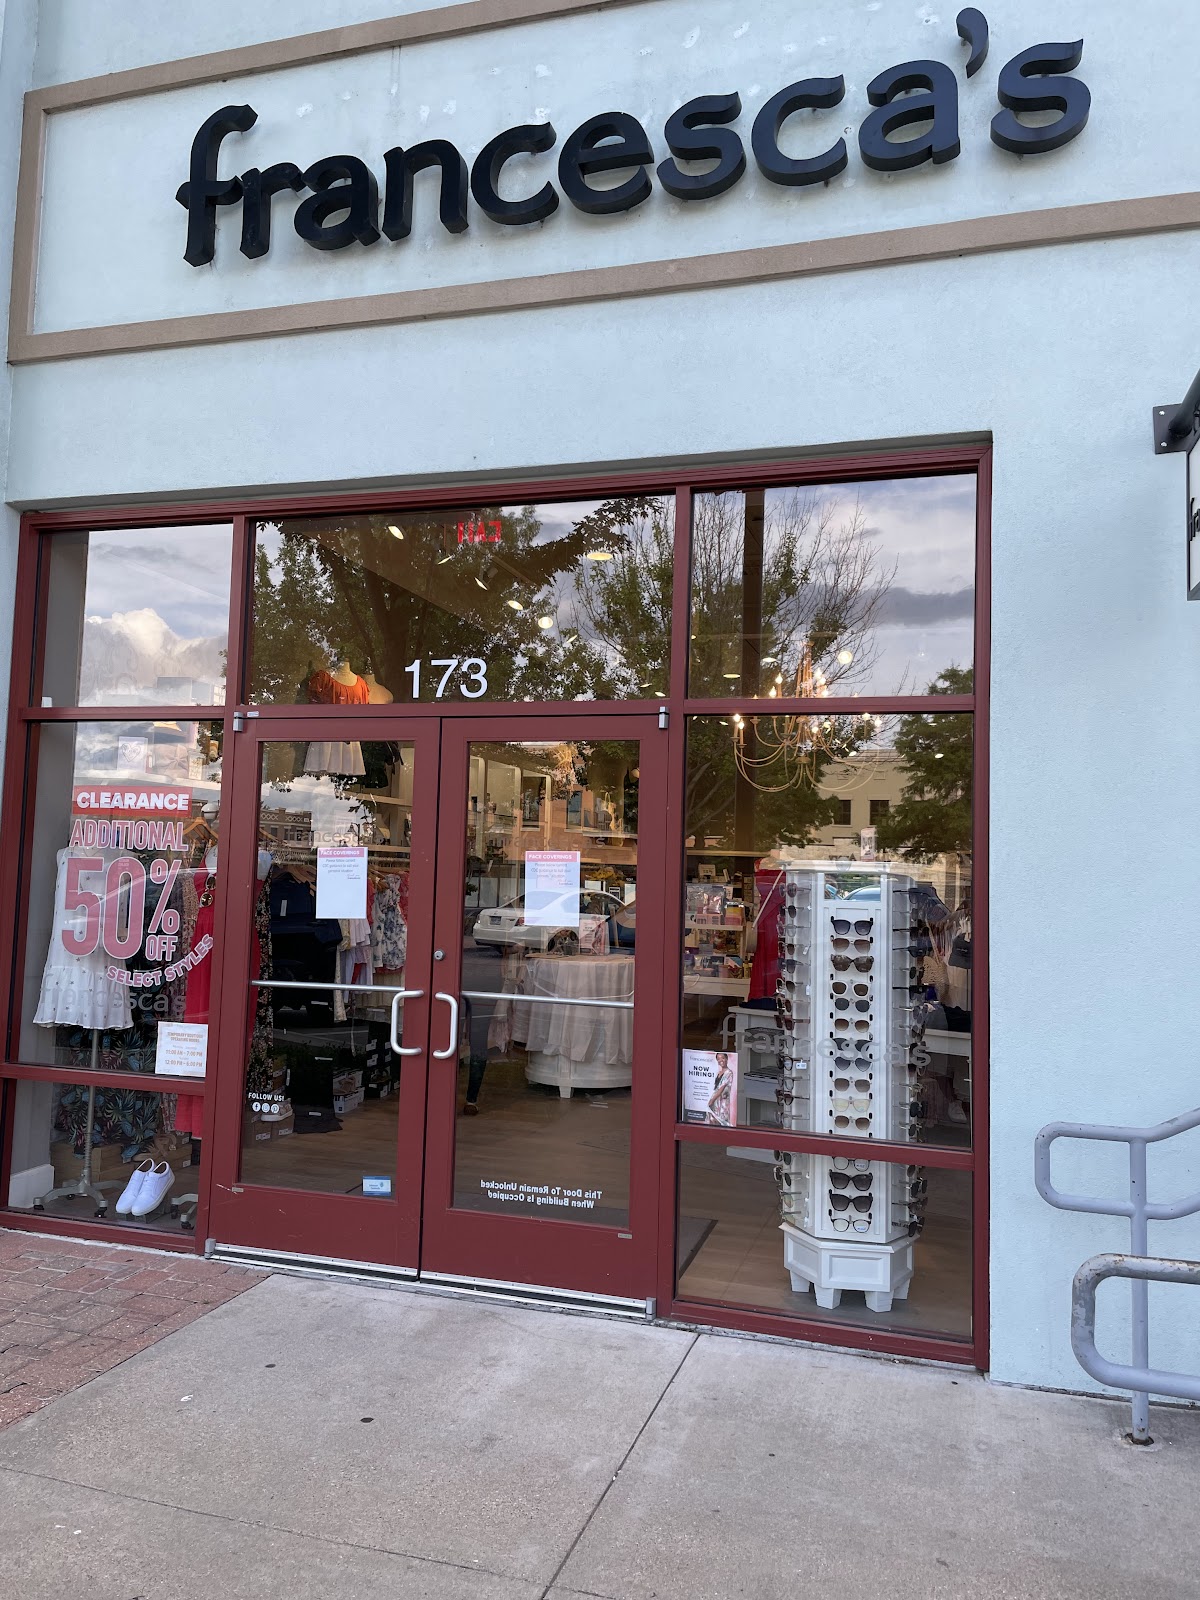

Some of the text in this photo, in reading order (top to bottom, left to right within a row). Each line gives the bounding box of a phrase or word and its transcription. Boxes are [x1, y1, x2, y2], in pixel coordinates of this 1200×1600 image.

[175, 7, 1092, 268] francesca's
[404, 657, 489, 699] 173
[76, 791, 190, 811] CLEARANCE
[69, 819, 190, 852] ADDITIONAL
[61, 856, 182, 960] 50%
[106, 933, 214, 988] SELECT STYLES
[145, 934, 178, 962] OFF
[688, 1070, 715, 1078] HIRING!
[248, 1092, 285, 1102] FOLLOW US!
